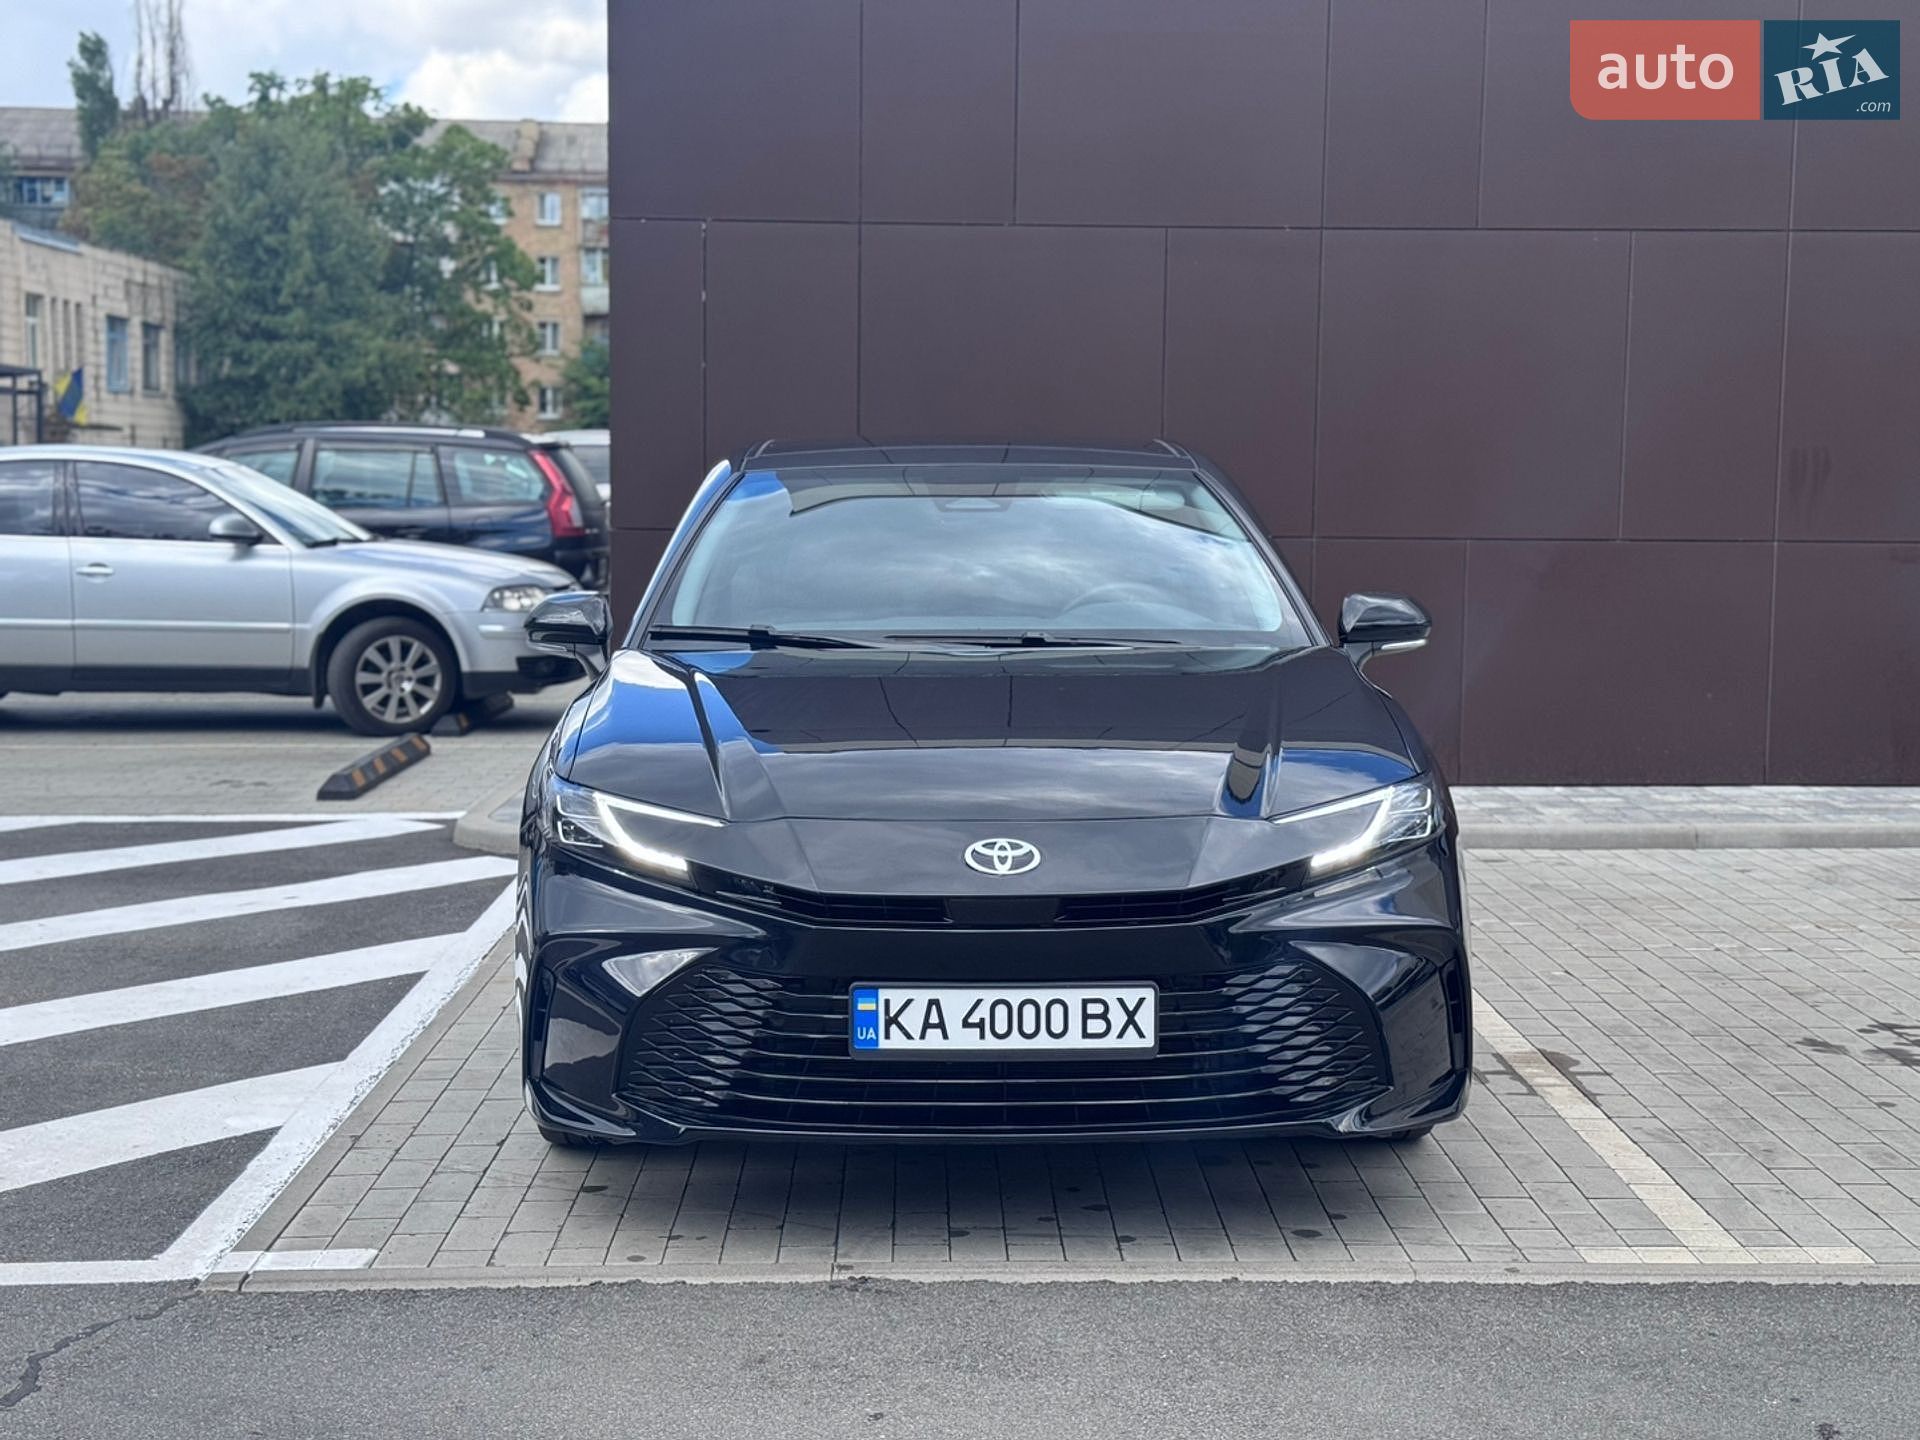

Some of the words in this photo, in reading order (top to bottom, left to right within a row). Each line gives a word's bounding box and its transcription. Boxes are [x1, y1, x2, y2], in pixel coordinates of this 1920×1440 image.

[883, 998, 949, 1040] KA
[961, 998, 1069, 1040] 4000
[1080, 997, 1147, 1040] BX
[857, 1026, 877, 1040] UA
